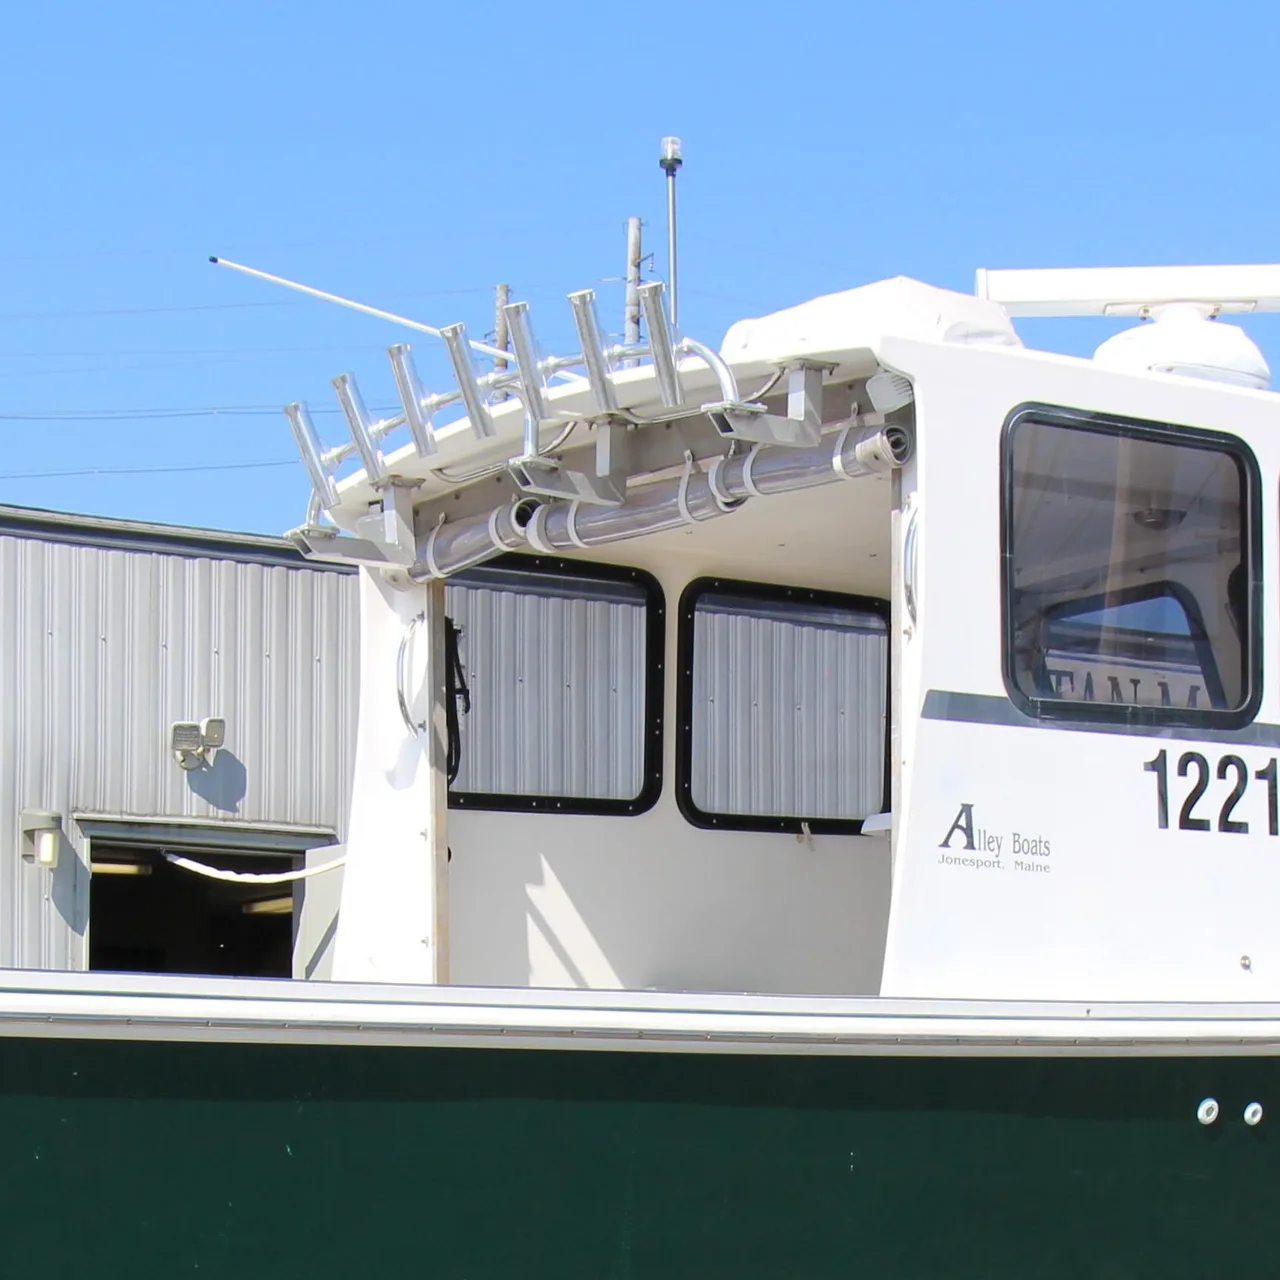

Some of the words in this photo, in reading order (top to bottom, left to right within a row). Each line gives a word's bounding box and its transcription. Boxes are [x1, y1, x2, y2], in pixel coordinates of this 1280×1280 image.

[938, 802, 1003, 858] Alley
[1012, 832, 1051, 857] Boats
[1014, 859, 1051, 873] Maine
